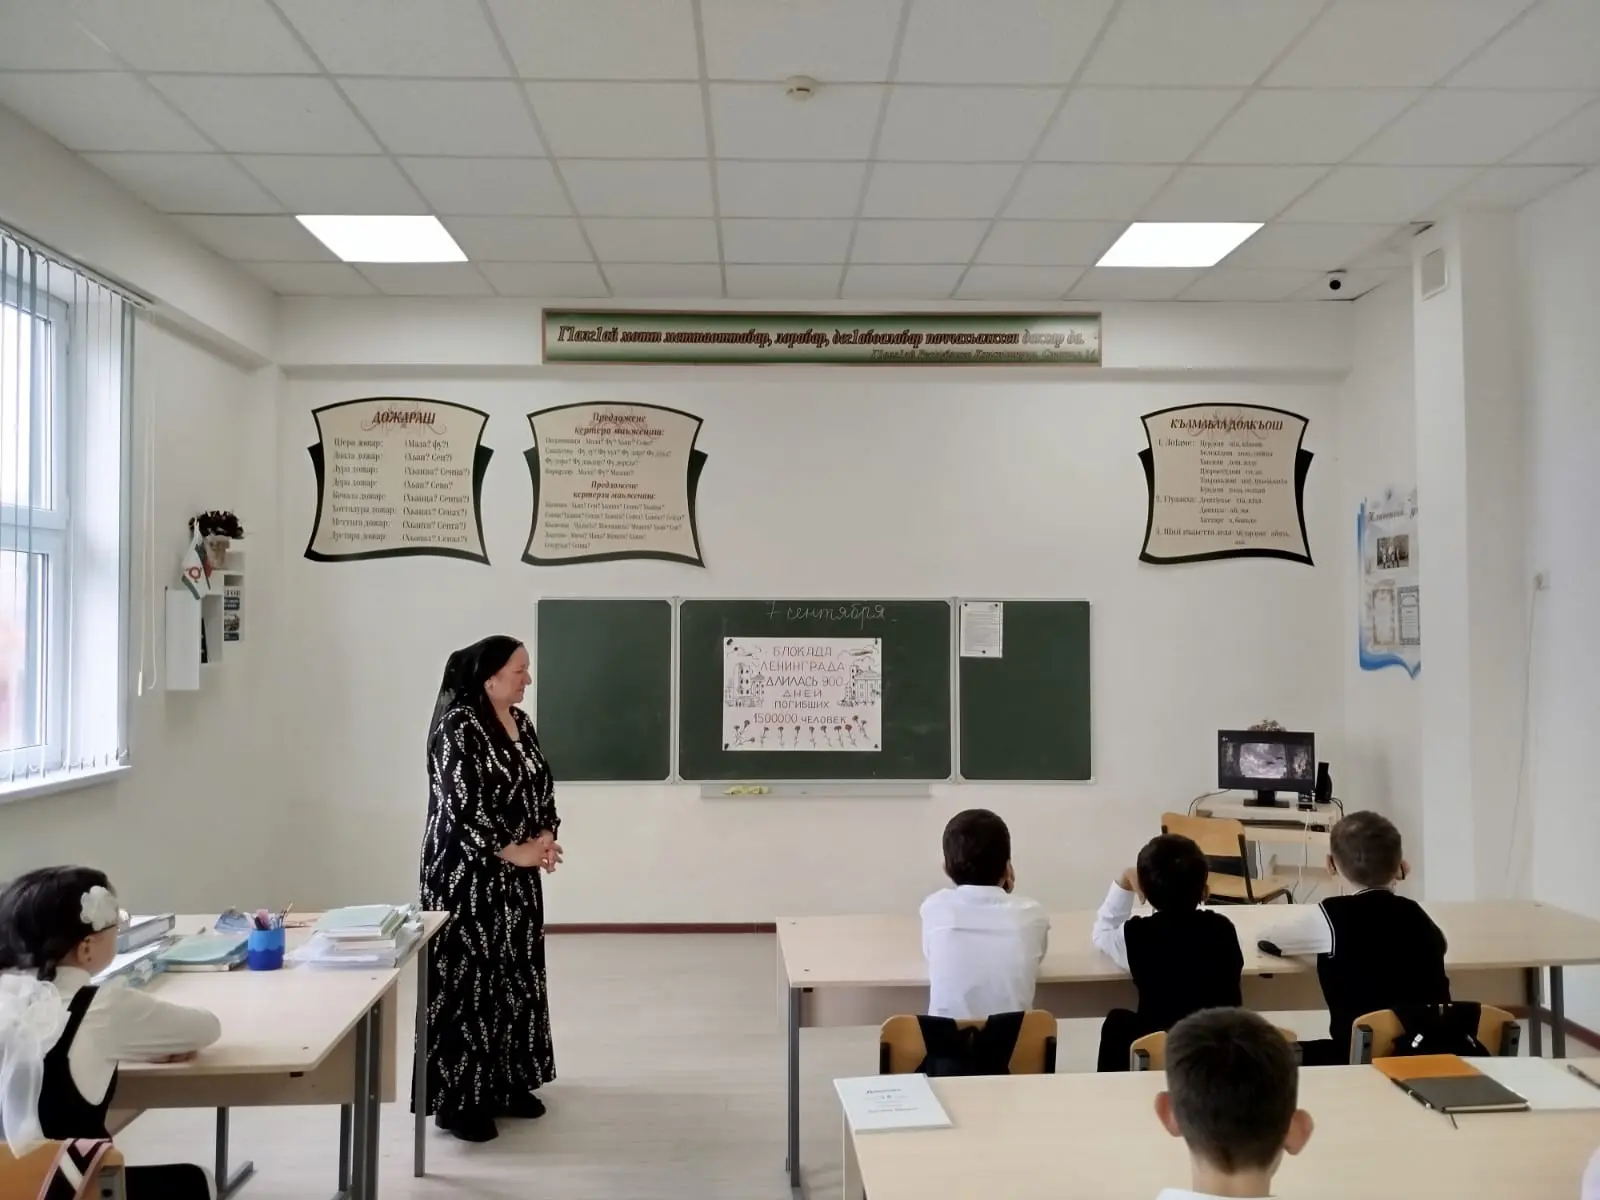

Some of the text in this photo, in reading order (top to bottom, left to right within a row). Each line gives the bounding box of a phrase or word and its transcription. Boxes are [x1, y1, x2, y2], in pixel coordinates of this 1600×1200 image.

[372, 411, 435, 424] ДОЖАРАШ
[760, 661, 845, 672] ЛЕНИНГРАДА
[766, 676, 844, 687] ДЛИЛАСЬ 900
[774, 700, 830, 709] ПОГИБШИХ
[754, 713, 847, 724] 1500000 ЧЕЛОВЕК
